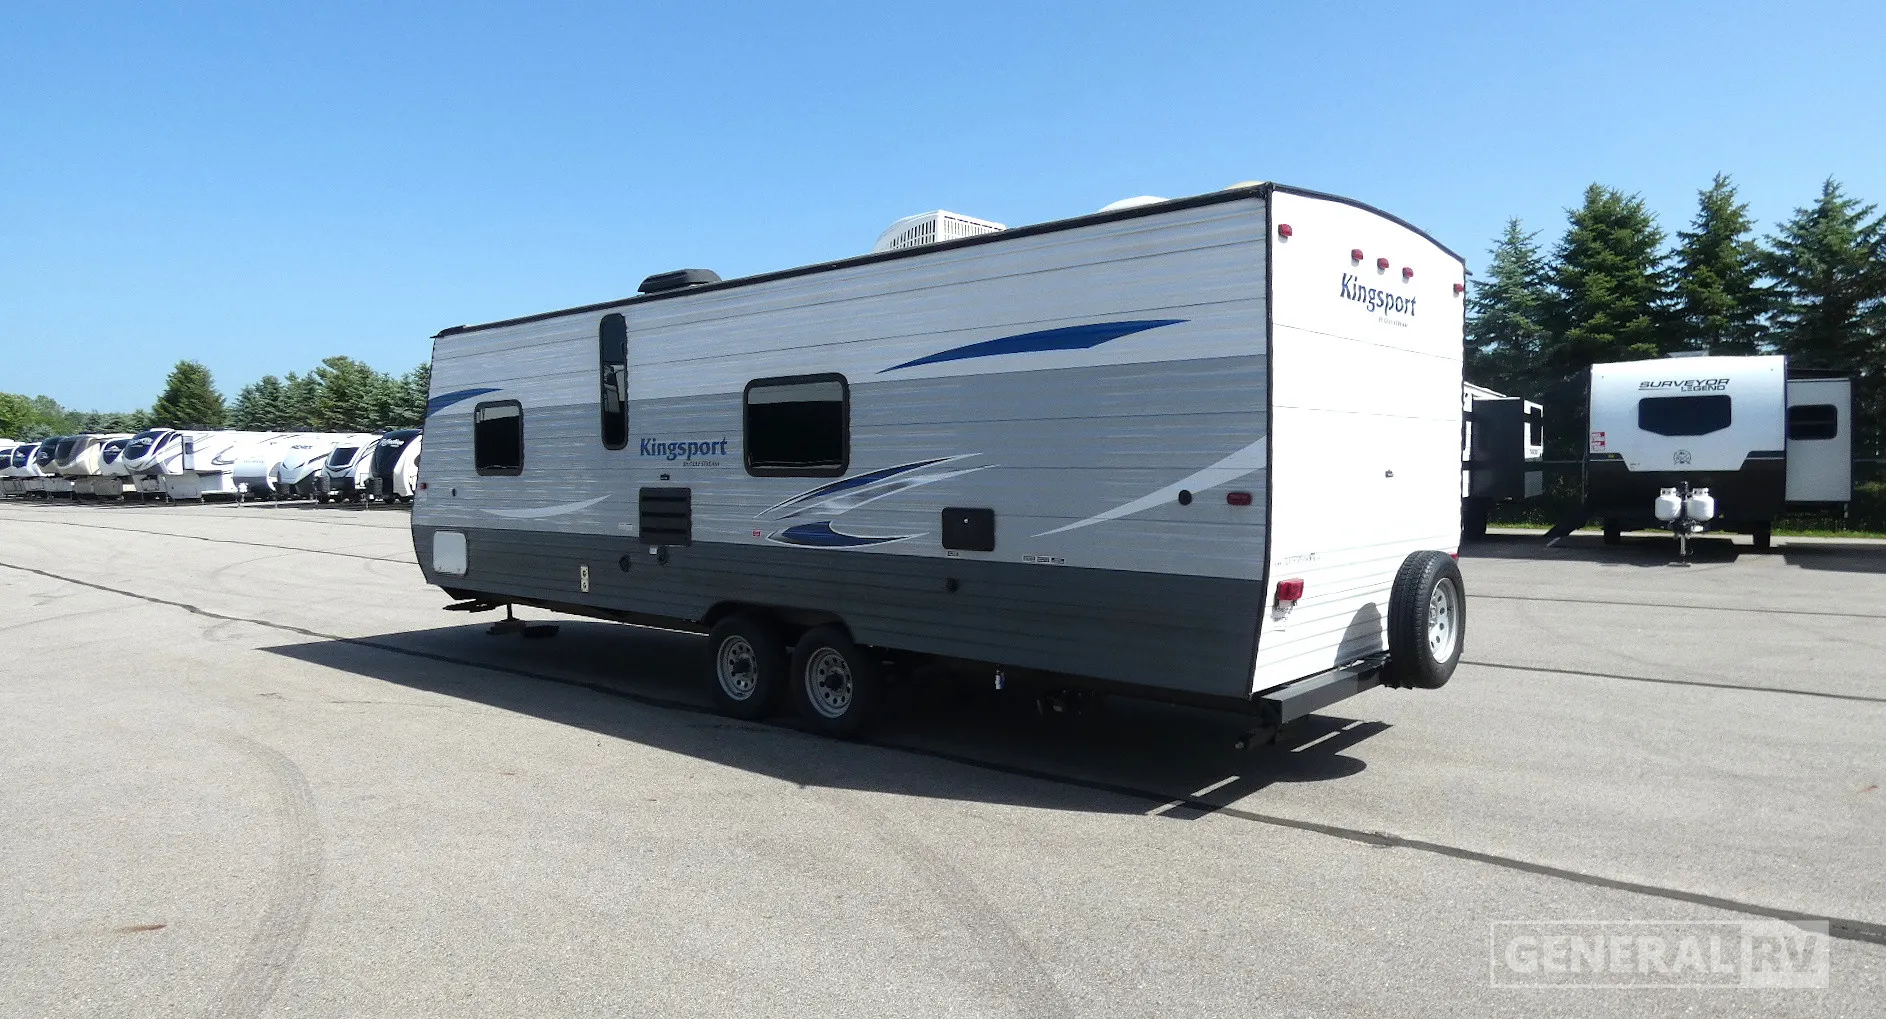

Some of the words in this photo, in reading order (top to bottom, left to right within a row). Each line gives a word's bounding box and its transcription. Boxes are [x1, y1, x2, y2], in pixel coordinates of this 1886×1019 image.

[1340, 272, 1416, 316] Kingsport
[1639, 379, 1730, 389] SURVEYOR
[640, 437, 728, 460] Kingsport
